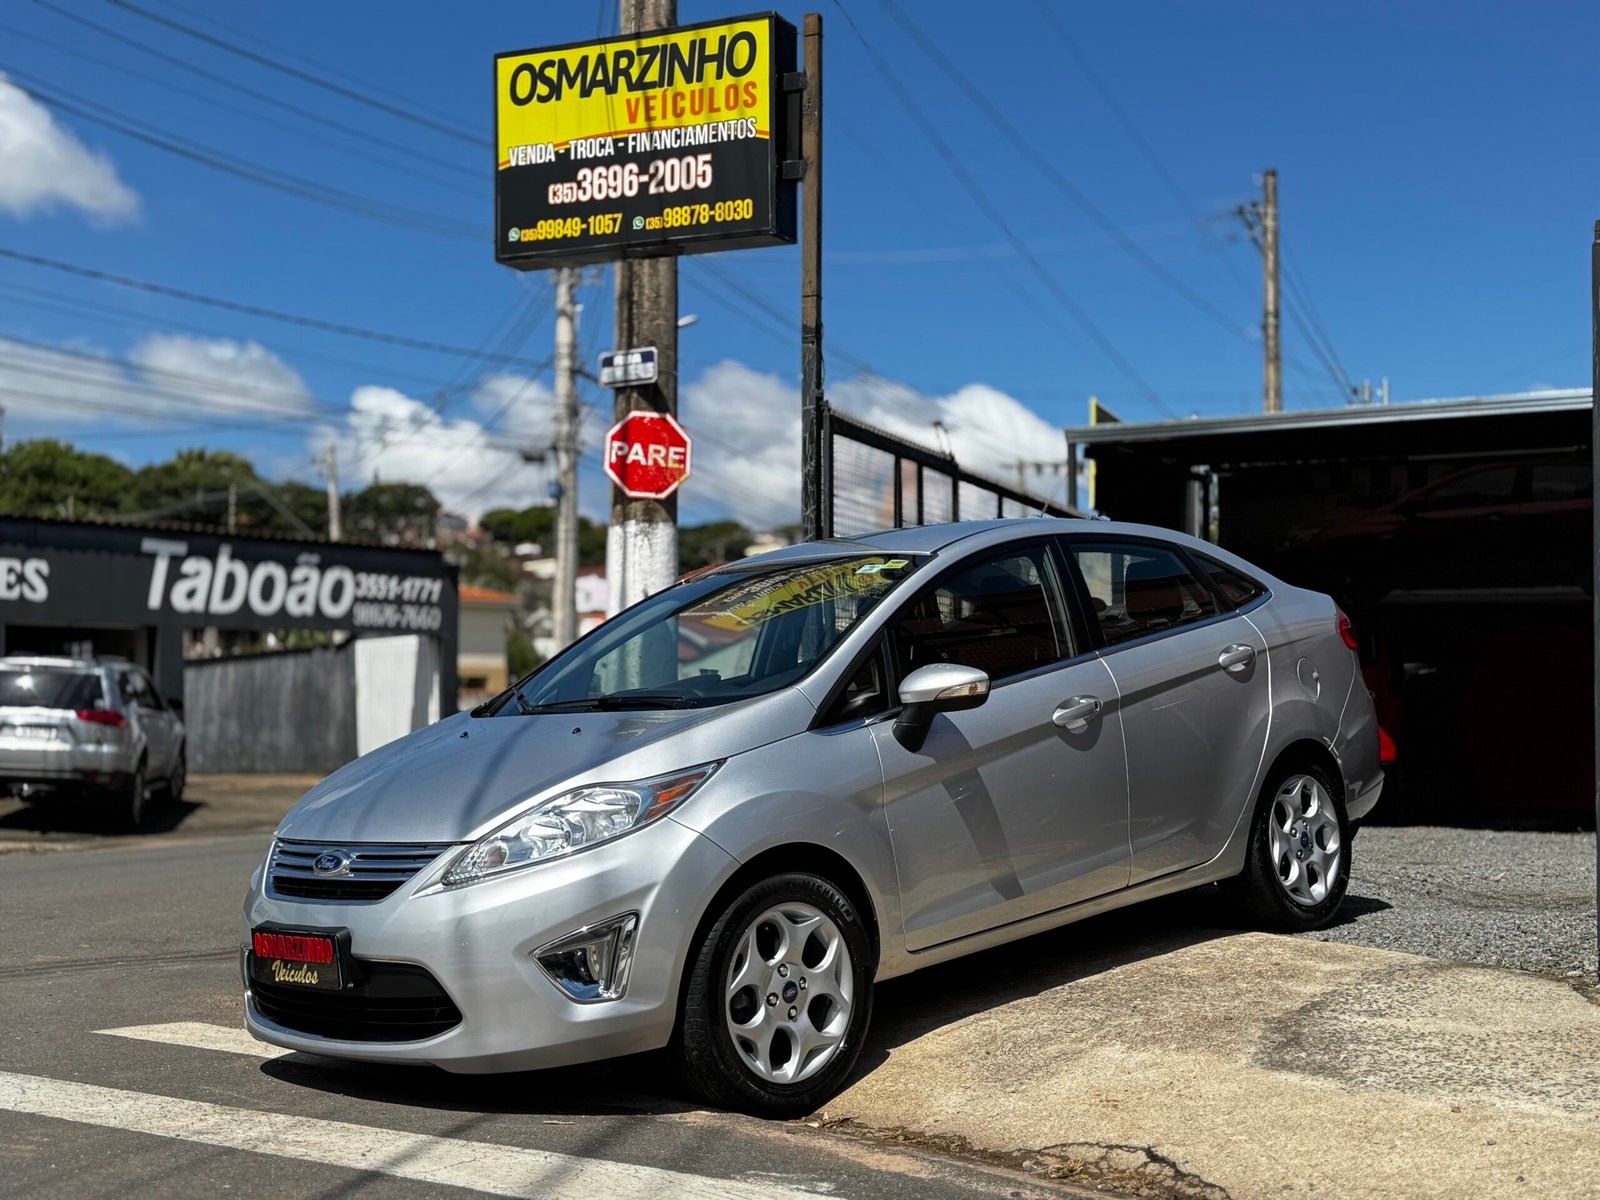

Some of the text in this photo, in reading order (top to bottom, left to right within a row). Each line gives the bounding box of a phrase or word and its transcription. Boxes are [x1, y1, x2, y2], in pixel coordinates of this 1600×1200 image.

[509, 31, 758, 107] OSMARZINHO
[626, 80, 758, 124] VEÍCULOS
[508, 142, 556, 167] VENDA
[568, 135, 615, 160] TROCA
[627, 117, 758, 154] FINANCIAMENTOS
[610, 440, 686, 469] PARE
[141, 537, 355, 619] Taboão
[317, 855, 338, 870] Ford
[254, 932, 333, 965] OSMARZINHO
